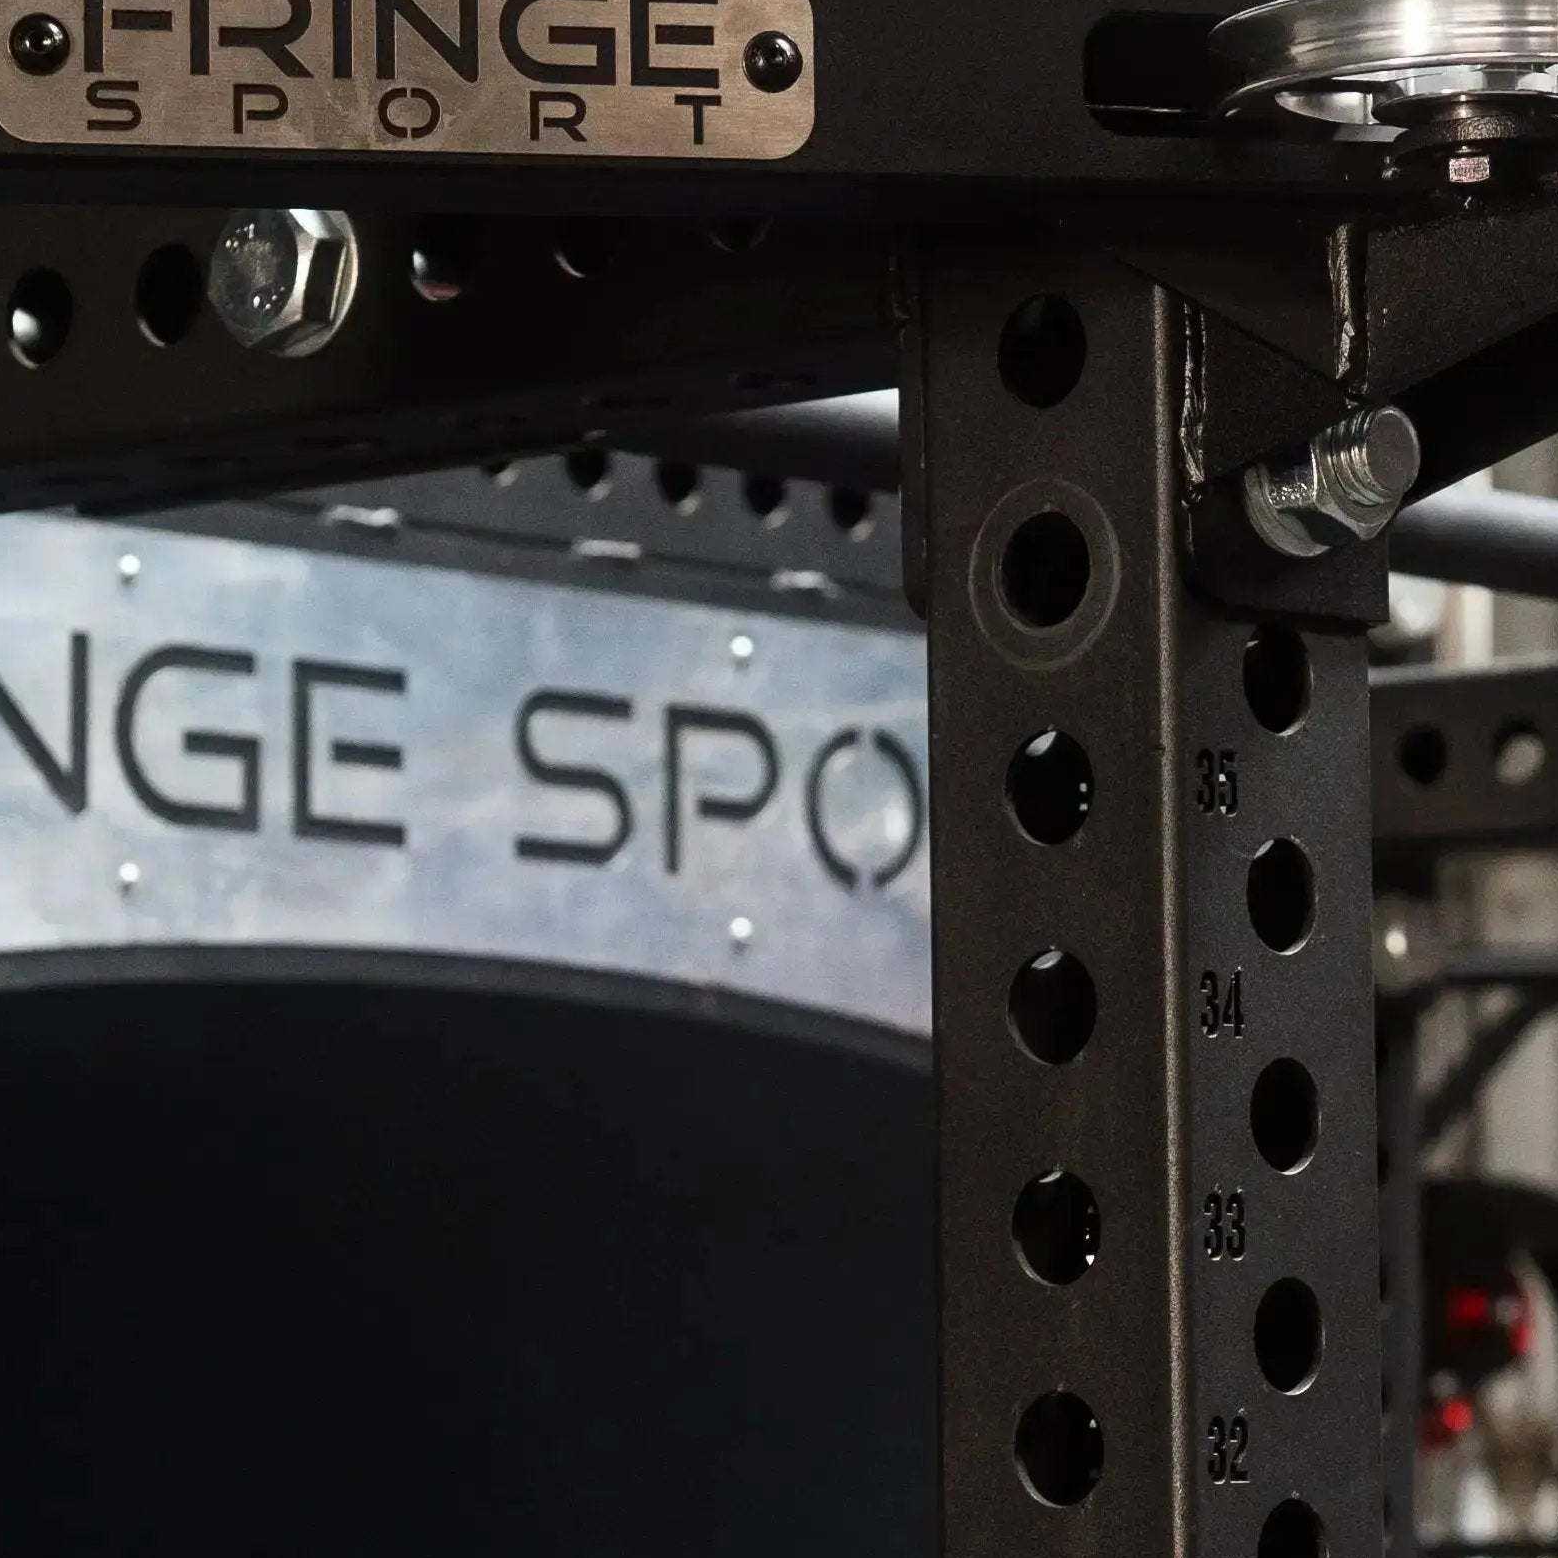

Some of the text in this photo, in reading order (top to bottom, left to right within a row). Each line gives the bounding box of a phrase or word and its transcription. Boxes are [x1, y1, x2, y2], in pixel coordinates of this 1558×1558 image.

[85, 79, 722, 145] SPORT
[1196, 747, 1238, 816] 35
[1199, 968, 1245, 1038] 34
[1203, 1192, 1246, 1261] 33
[1207, 1415, 1250, 1485] 32
